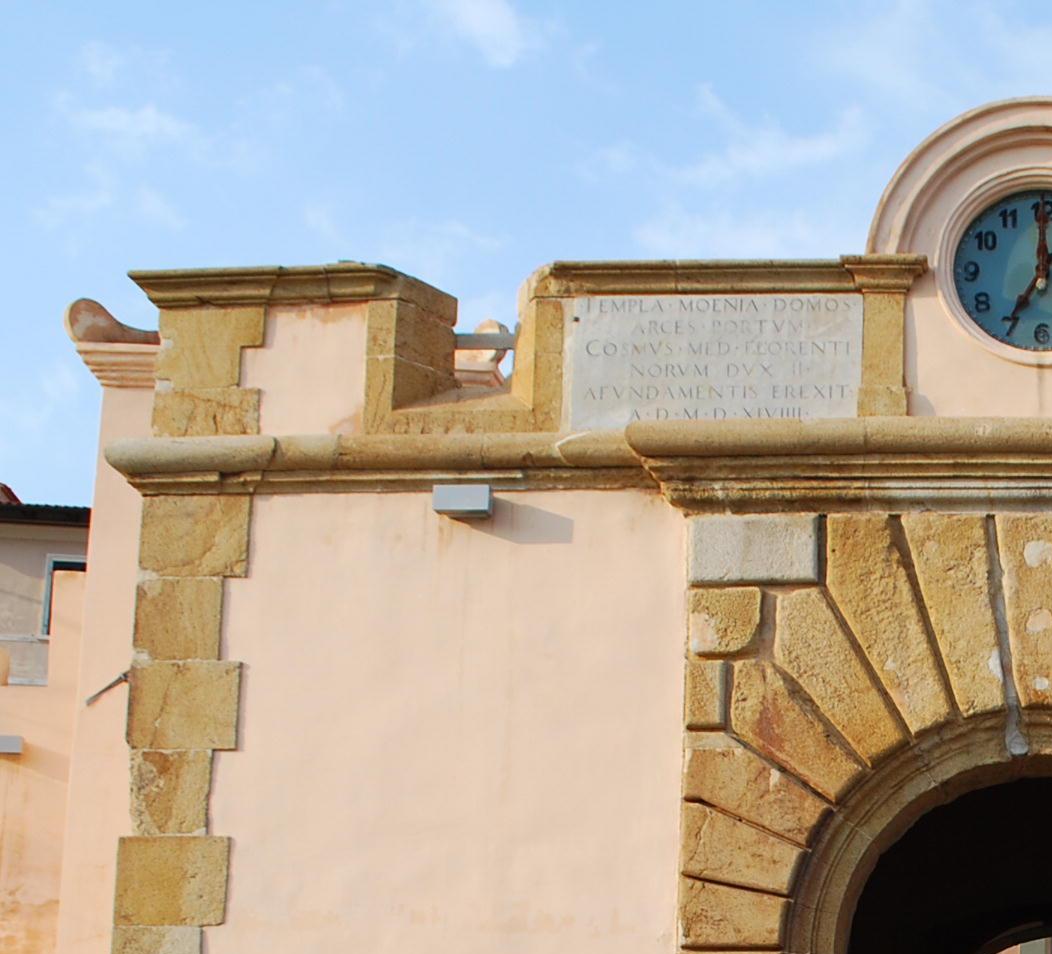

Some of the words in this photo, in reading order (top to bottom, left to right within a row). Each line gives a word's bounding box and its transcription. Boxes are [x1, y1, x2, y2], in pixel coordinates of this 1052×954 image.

[999, 208, 1018, 229] 11
[974, 230, 997, 252] 10
[963, 260, 980, 283] 9
[679, 298, 759, 312] MOENIA
[773, 298, 851, 312] DOMOS
[974, 291, 991, 313] 8
[631, 320, 696, 334] ARCES
[711, 319, 804, 334] PORTVM
[1001, 316, 1020, 337] 7
[1033, 322, 1050, 345] 6
[585, 339, 673, 356] COSMVS
[630, 363, 709, 377] NORVM
[726, 363, 773, 377] DVX
[772, 384, 849, 399] EREXIT
